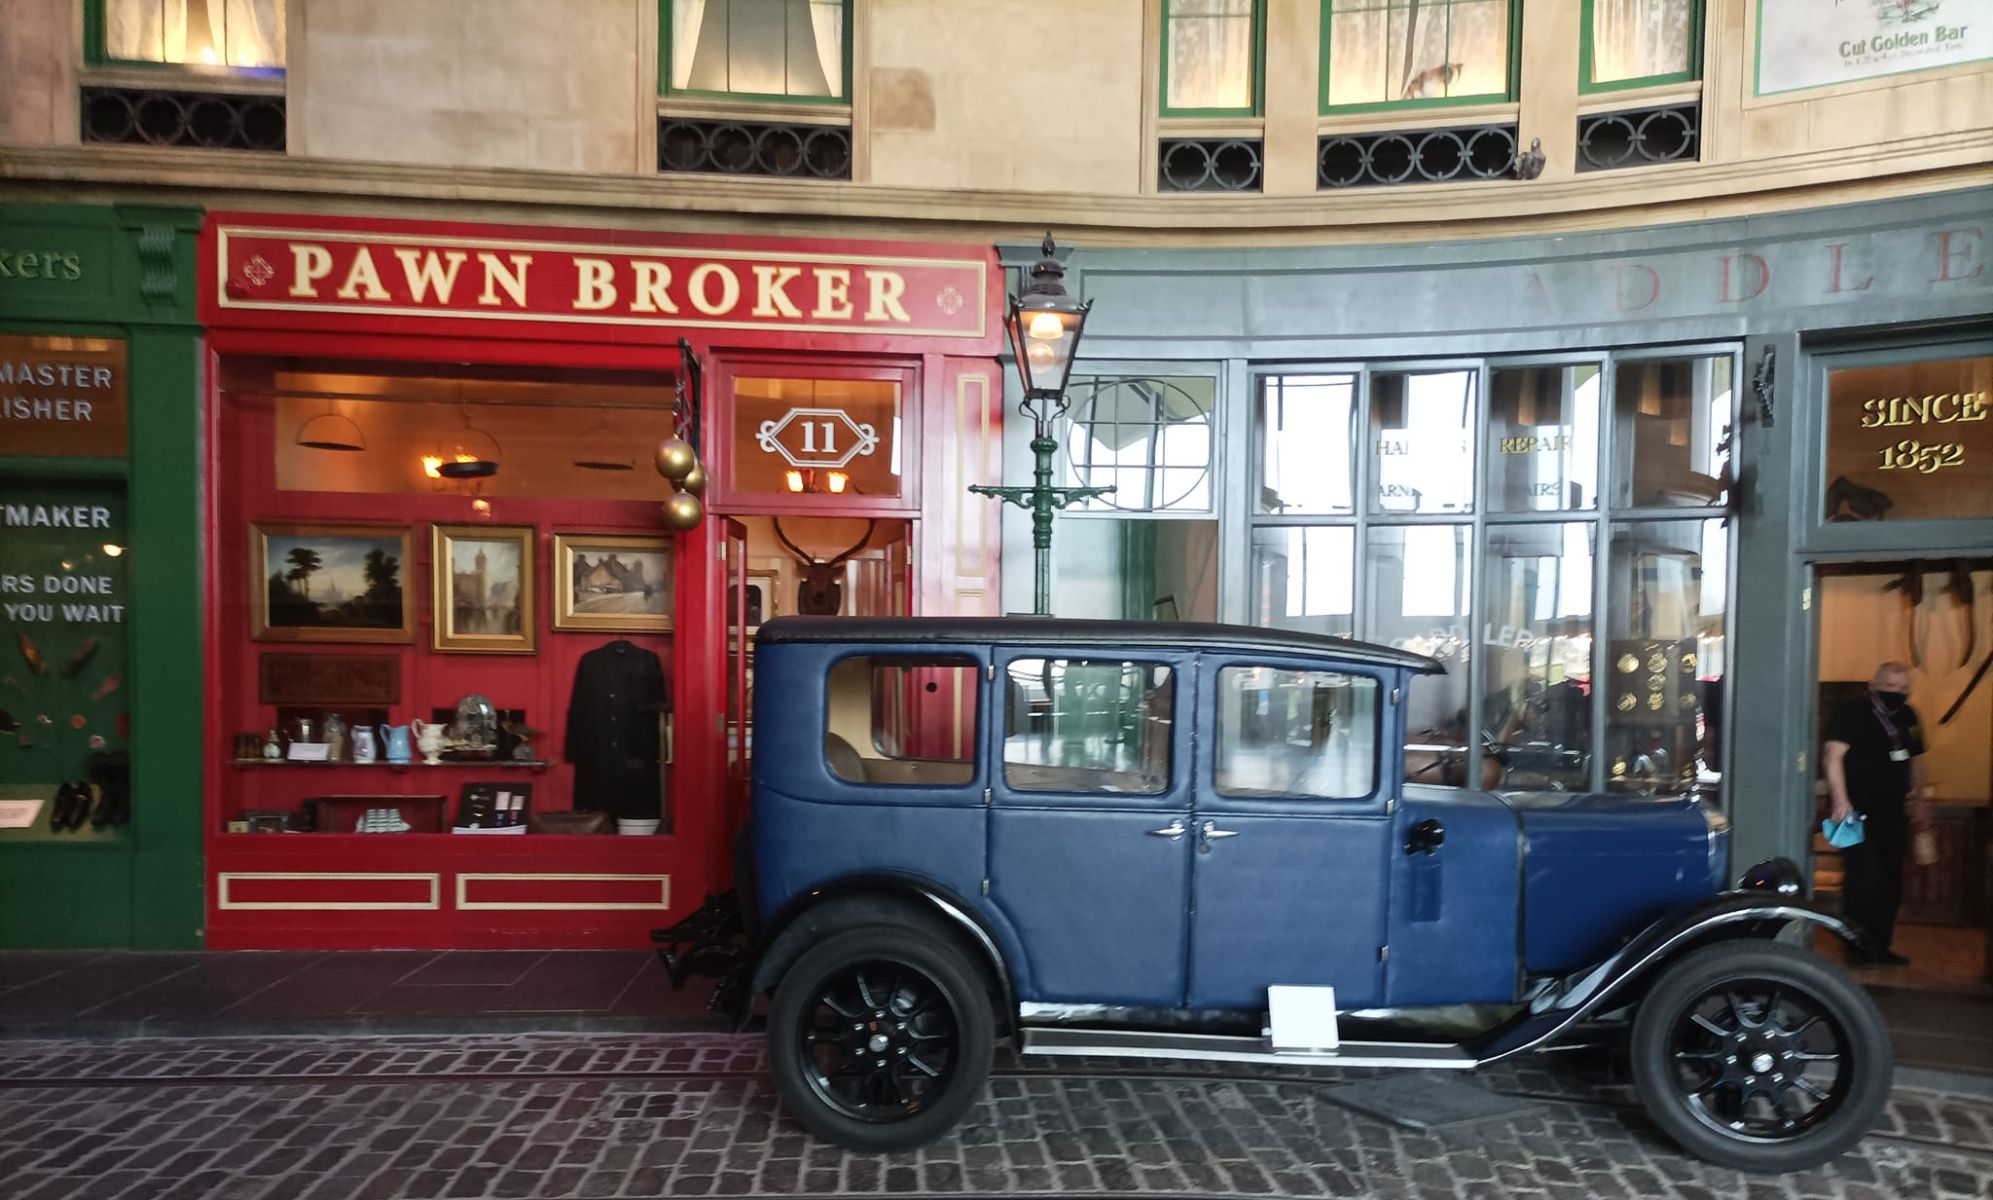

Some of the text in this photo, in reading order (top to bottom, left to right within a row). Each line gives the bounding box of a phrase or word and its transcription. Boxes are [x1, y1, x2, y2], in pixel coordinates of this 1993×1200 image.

[1839, 40, 1866, 58] Cut
[1871, 31, 1929, 53] Golden
[1935, 26, 1968, 43] Bar
[287, 244, 912, 323] PAWN BROKER
[0, 361, 113, 389] MASTER
[0, 396, 93, 422] ISHER
[1861, 391, 1988, 428] SINCE
[801, 421, 838, 453] 11
[1878, 439, 1966, 474] 1852
[44, 574, 113, 595] DONE
[4, 603, 125, 623] YOU WAIT
